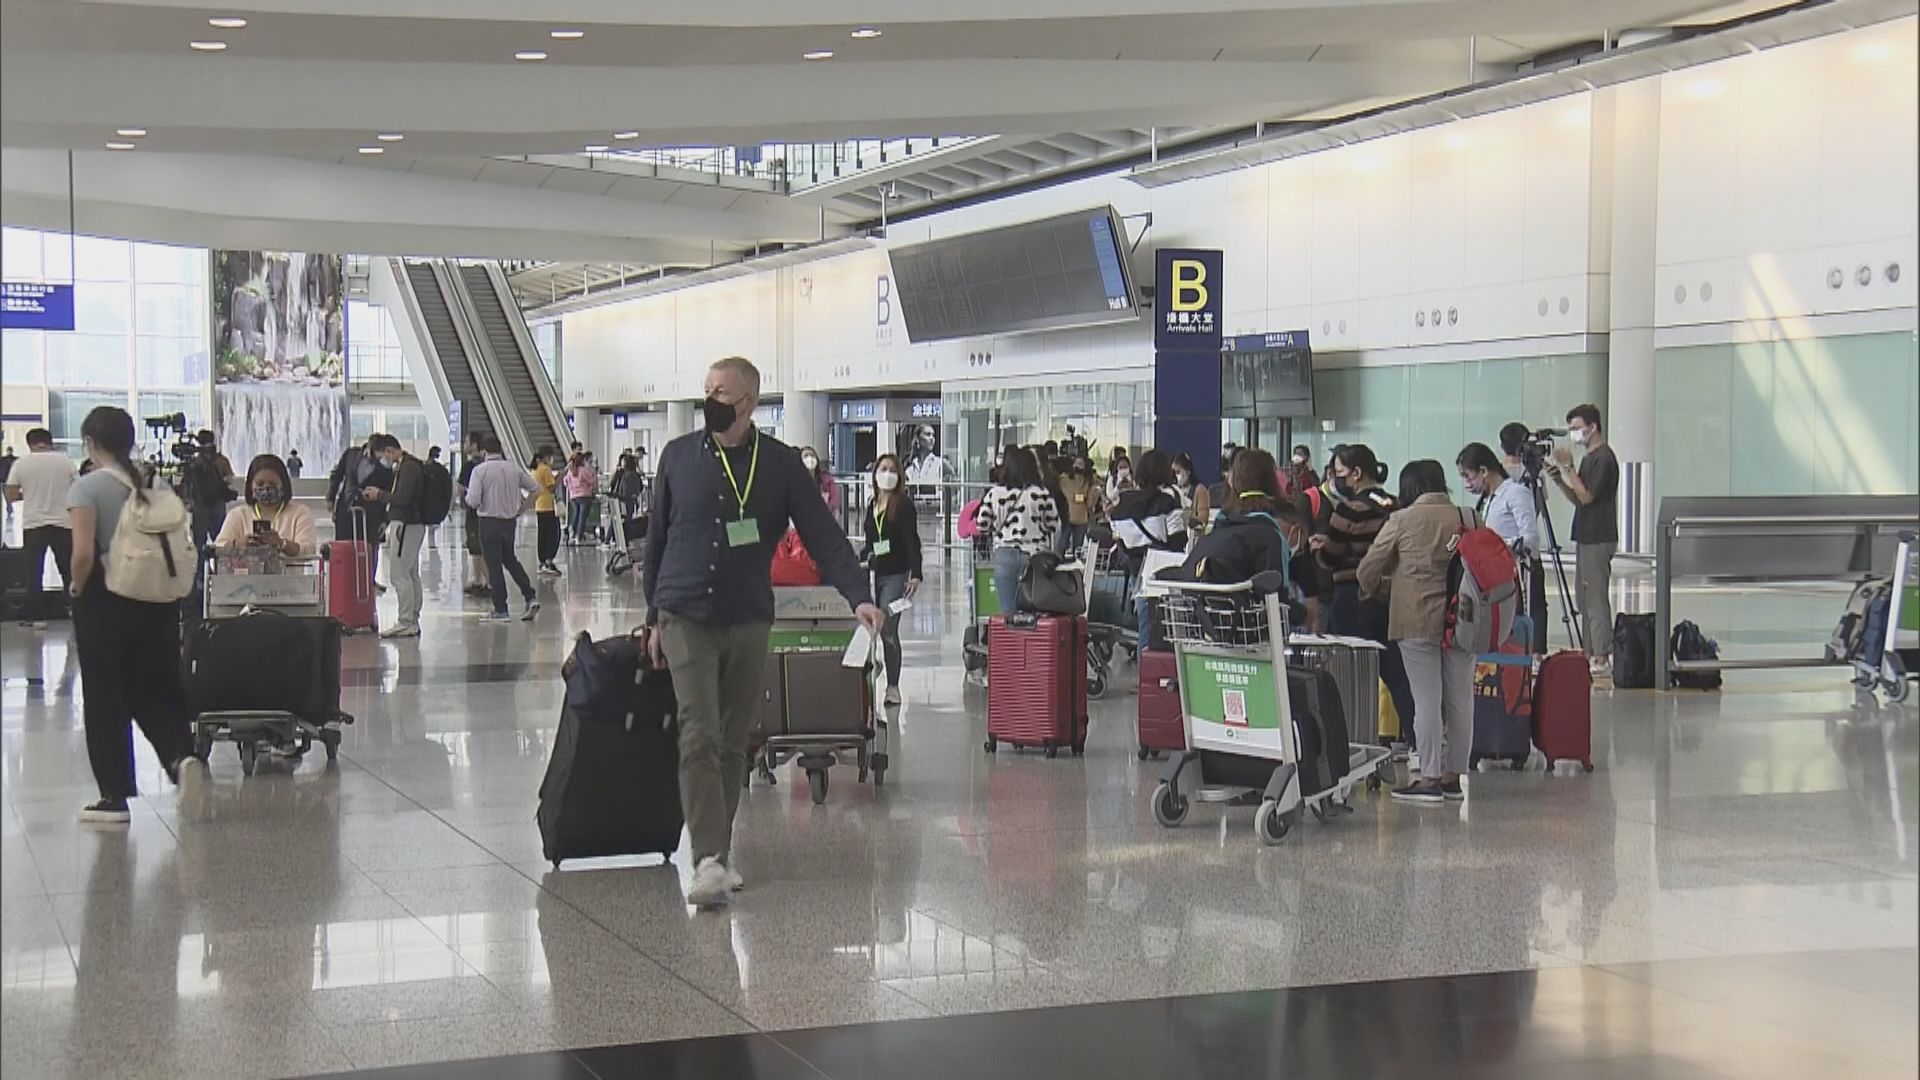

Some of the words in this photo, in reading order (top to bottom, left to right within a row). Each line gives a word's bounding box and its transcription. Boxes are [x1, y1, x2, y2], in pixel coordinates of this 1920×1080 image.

[878, 276, 890, 325] B
[1172, 260, 1208, 311] B
[1167, 324, 1196, 333] Arrivals
[1198, 324, 1213, 333] Hall
